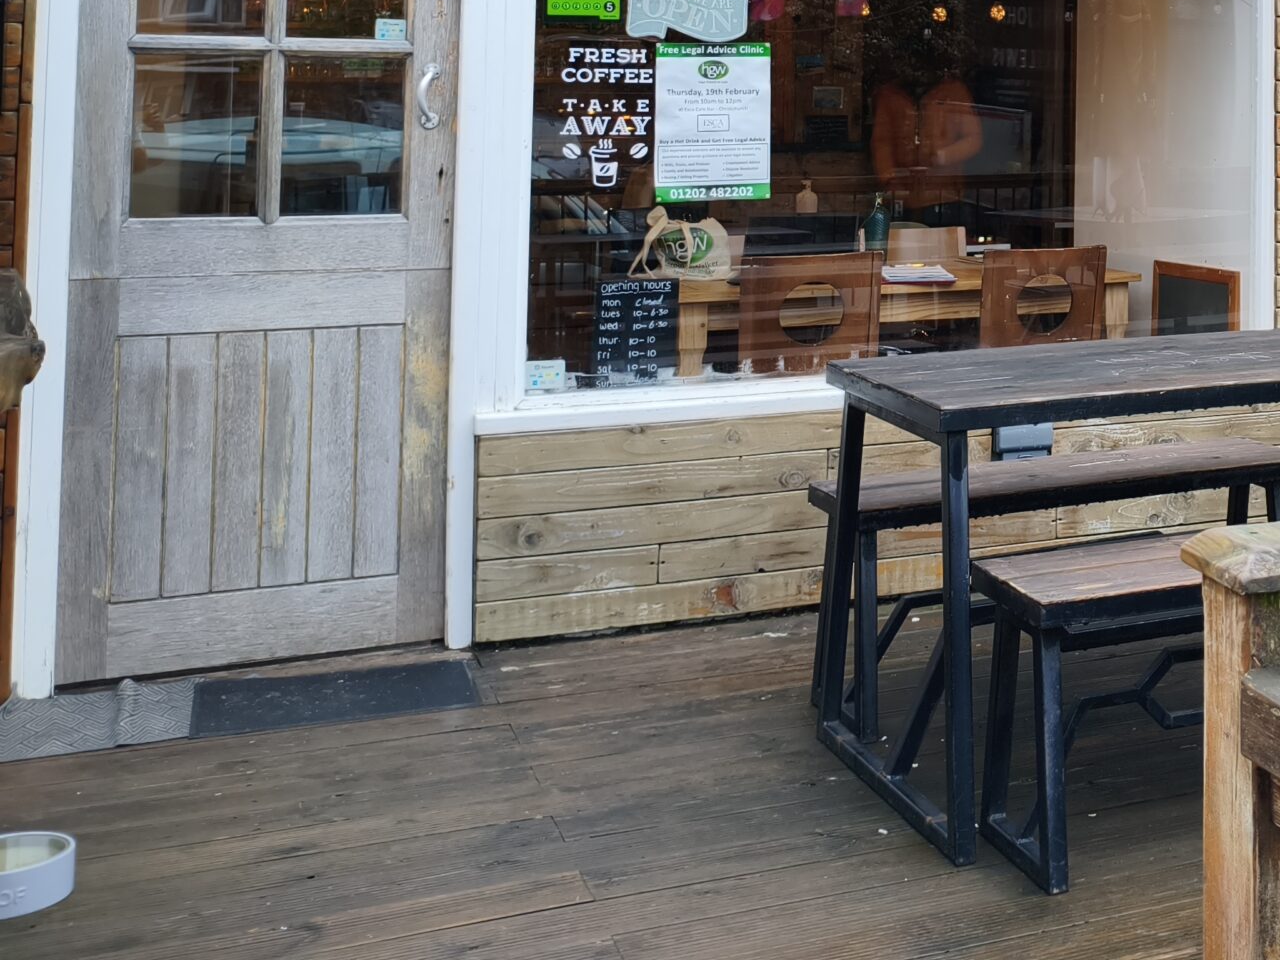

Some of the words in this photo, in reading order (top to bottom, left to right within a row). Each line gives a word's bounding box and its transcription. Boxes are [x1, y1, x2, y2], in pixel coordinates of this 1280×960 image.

[711, 0, 734, 9] ARE
[568, 47, 648, 64] FRESH
[659, 46, 679, 54] Free
[681, 46, 705, 55] Legal
[706, 45, 737, 54] Advice
[739, 45, 764, 54] Clinic
[561, 67, 654, 84] COFFEE
[701, 63, 727, 78] hgw
[667, 88, 704, 97] Thursday,
[725, 88, 760, 97] February
[559, 115, 652, 136] AWAY
[670, 189, 707, 200] 01202
[709, 186, 754, 198] 482202
